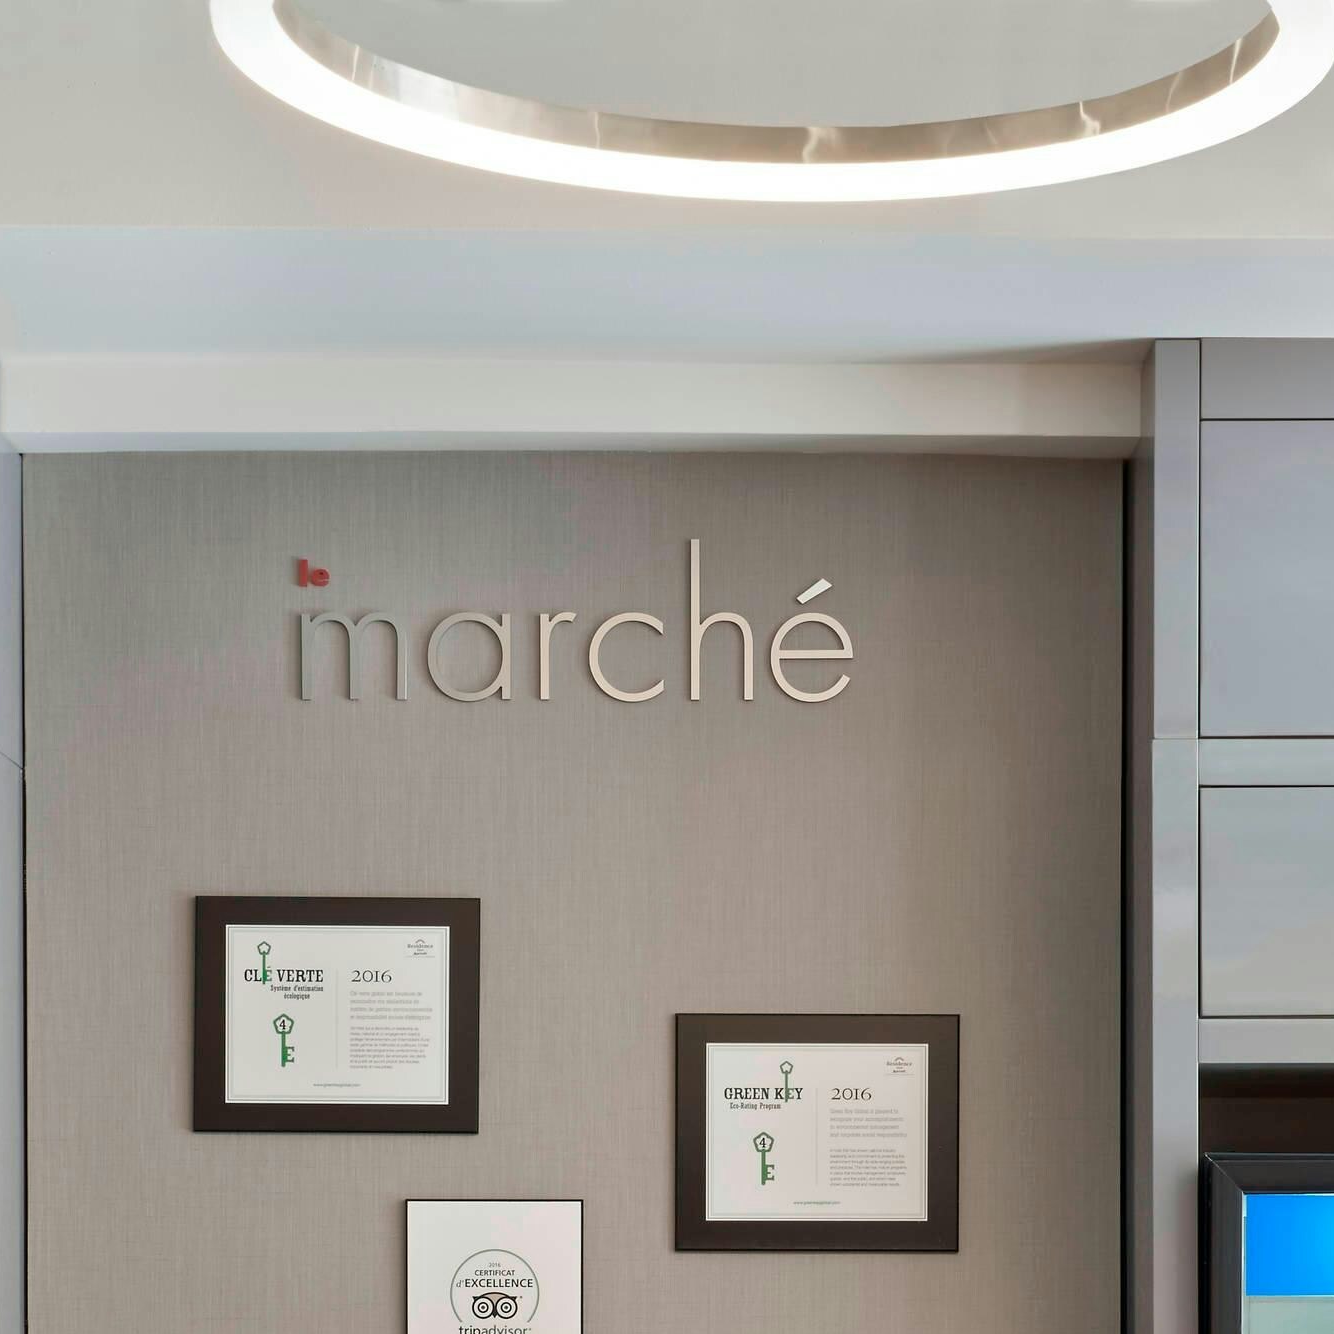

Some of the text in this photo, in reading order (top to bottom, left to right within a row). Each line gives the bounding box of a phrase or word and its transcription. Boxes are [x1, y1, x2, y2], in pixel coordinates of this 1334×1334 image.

[297, 559, 330, 588] le
[300, 539, 855, 703] marché
[277, 969, 324, 982] VERTE
[351, 970, 392, 983] 2016
[270, 985, 324, 993] Système d'estimation
[284, 992, 310, 1000] écologique
[279, 1019, 286, 1030] 4
[724, 1087, 803, 1100] GREEN KEY
[831, 1087, 872, 1101] 2016
[730, 1102, 781, 1110] Eco-Rating Program
[759, 1137, 766, 1148] 4
[456, 1279, 533, 1288] d'EXCELLENCE
